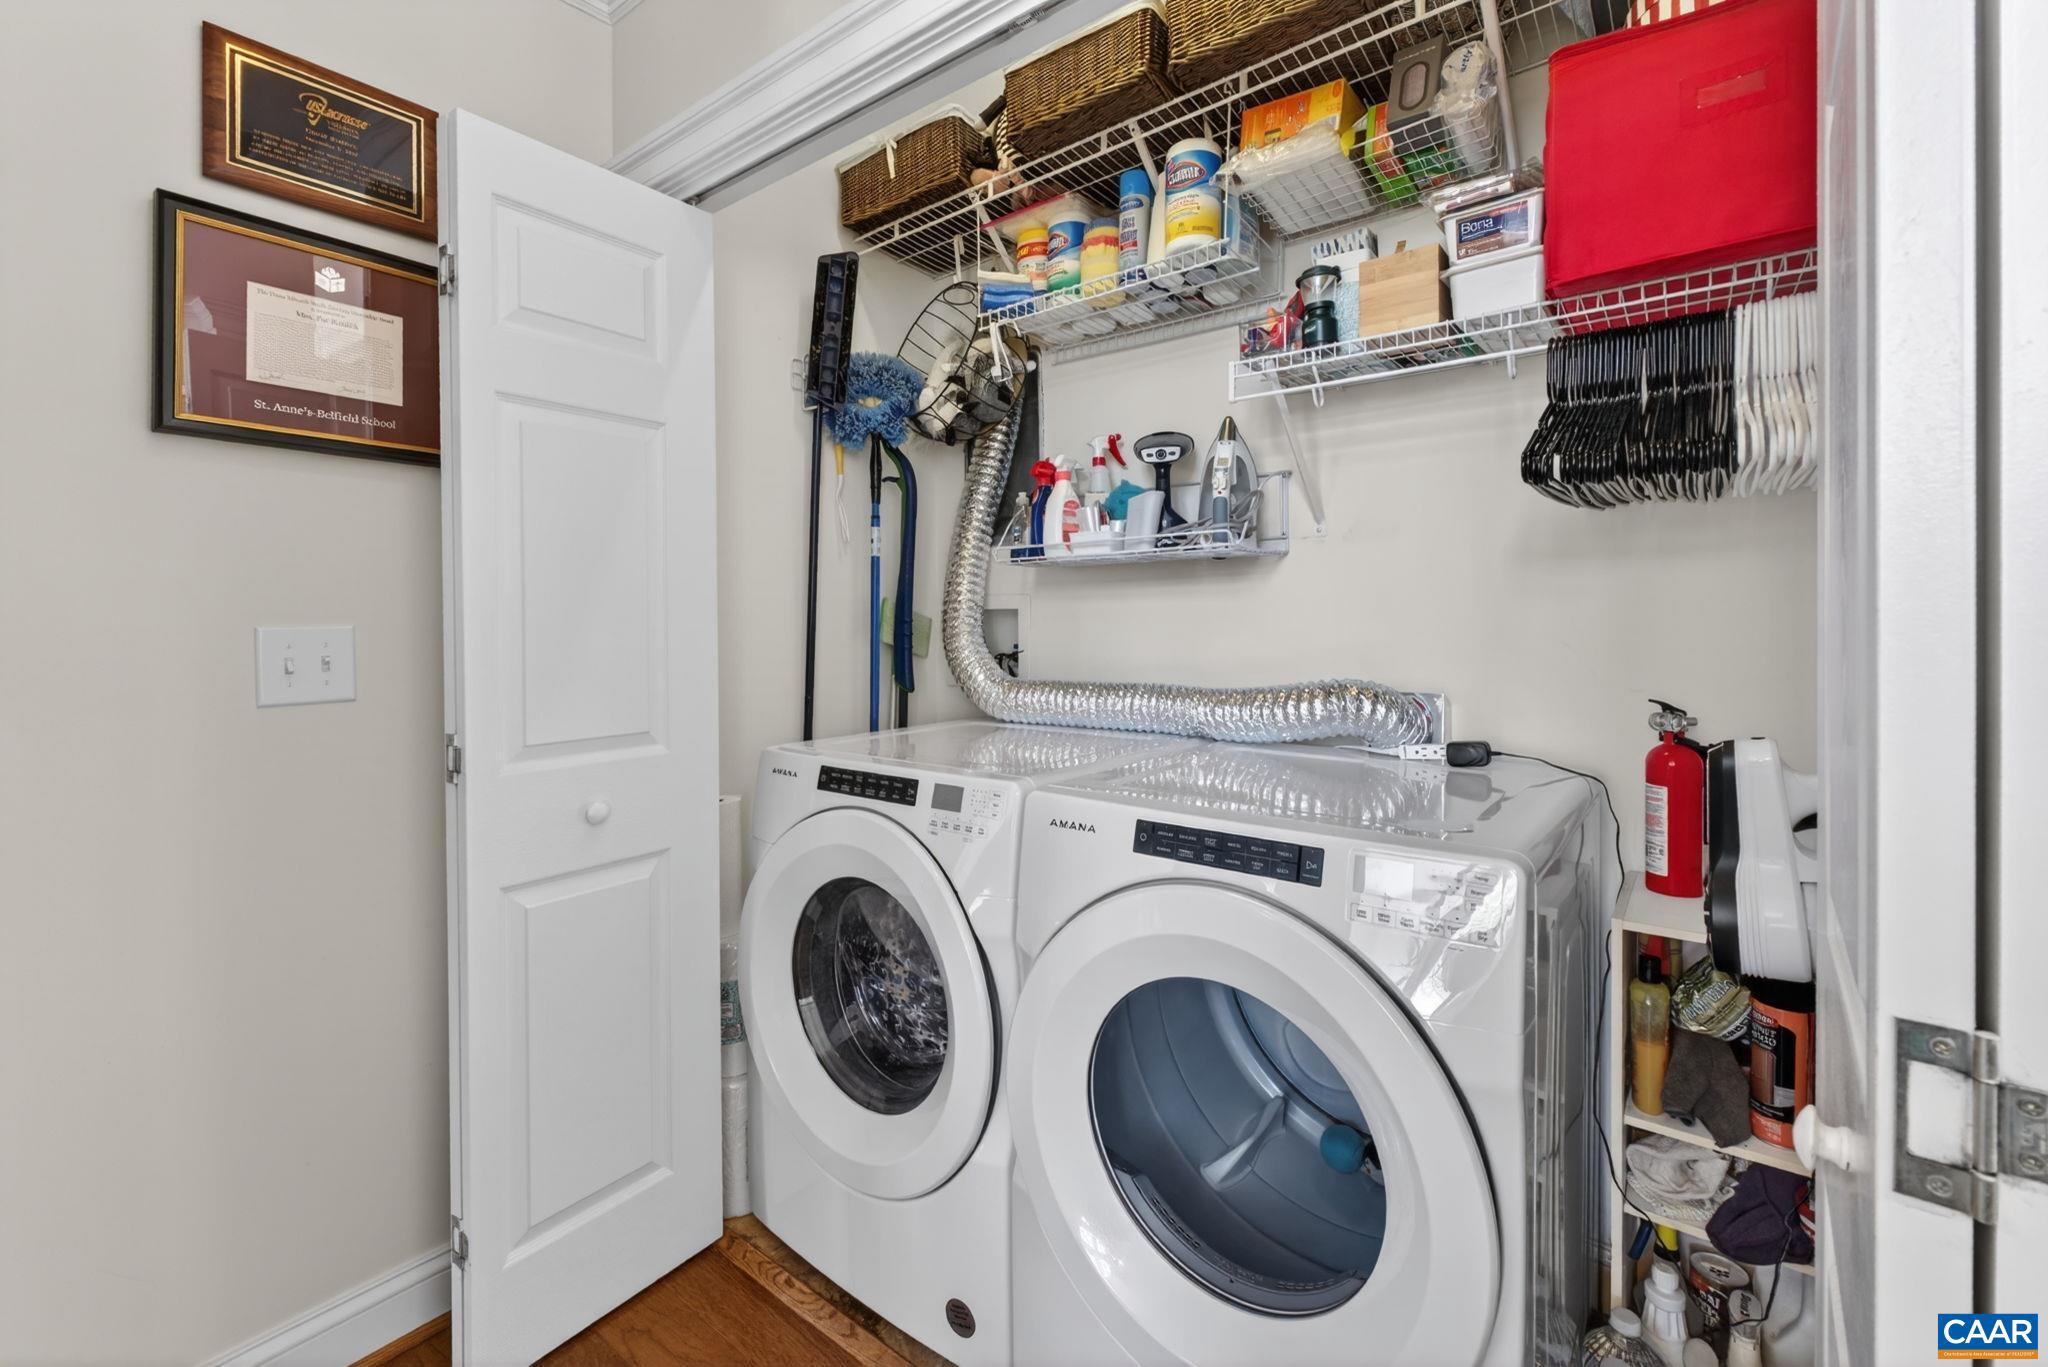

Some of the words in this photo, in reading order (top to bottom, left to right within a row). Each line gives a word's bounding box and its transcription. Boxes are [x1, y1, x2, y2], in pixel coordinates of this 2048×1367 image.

[1461, 218, 1494, 234] Bona
[254, 399, 271, 410] St.
[273, 403, 360, 424] Anne's-Belfield
[361, 416, 396, 429] School
[1050, 818, 1096, 833] AMANA
